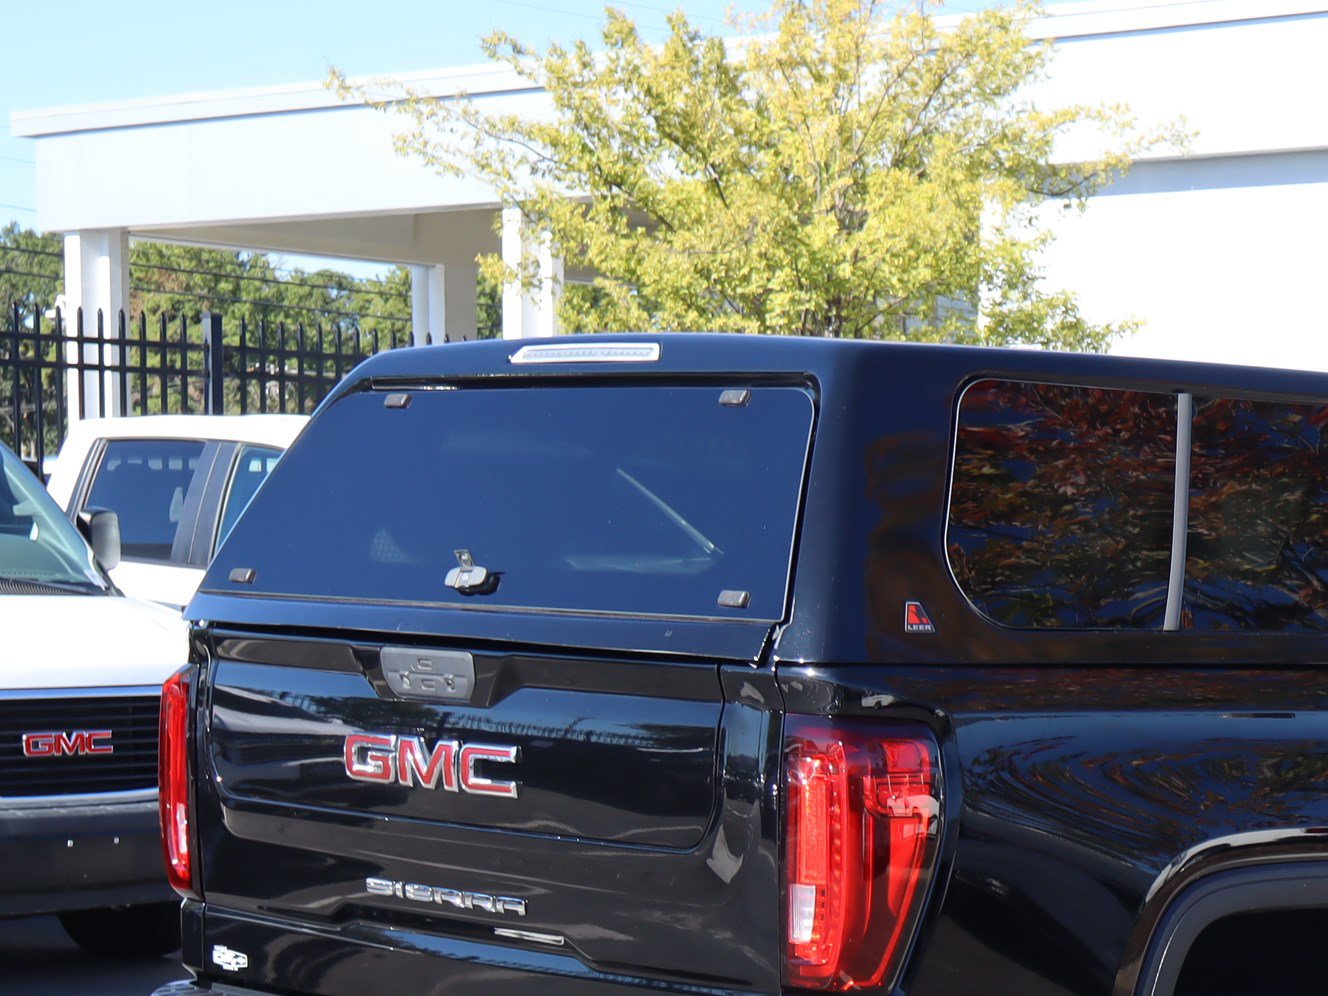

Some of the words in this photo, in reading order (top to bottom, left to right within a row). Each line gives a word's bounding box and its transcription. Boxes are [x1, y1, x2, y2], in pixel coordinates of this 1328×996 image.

[22, 730, 113, 757] GMC
[344, 733, 521, 799] GMC
[366, 876, 527, 916] SIERRA
